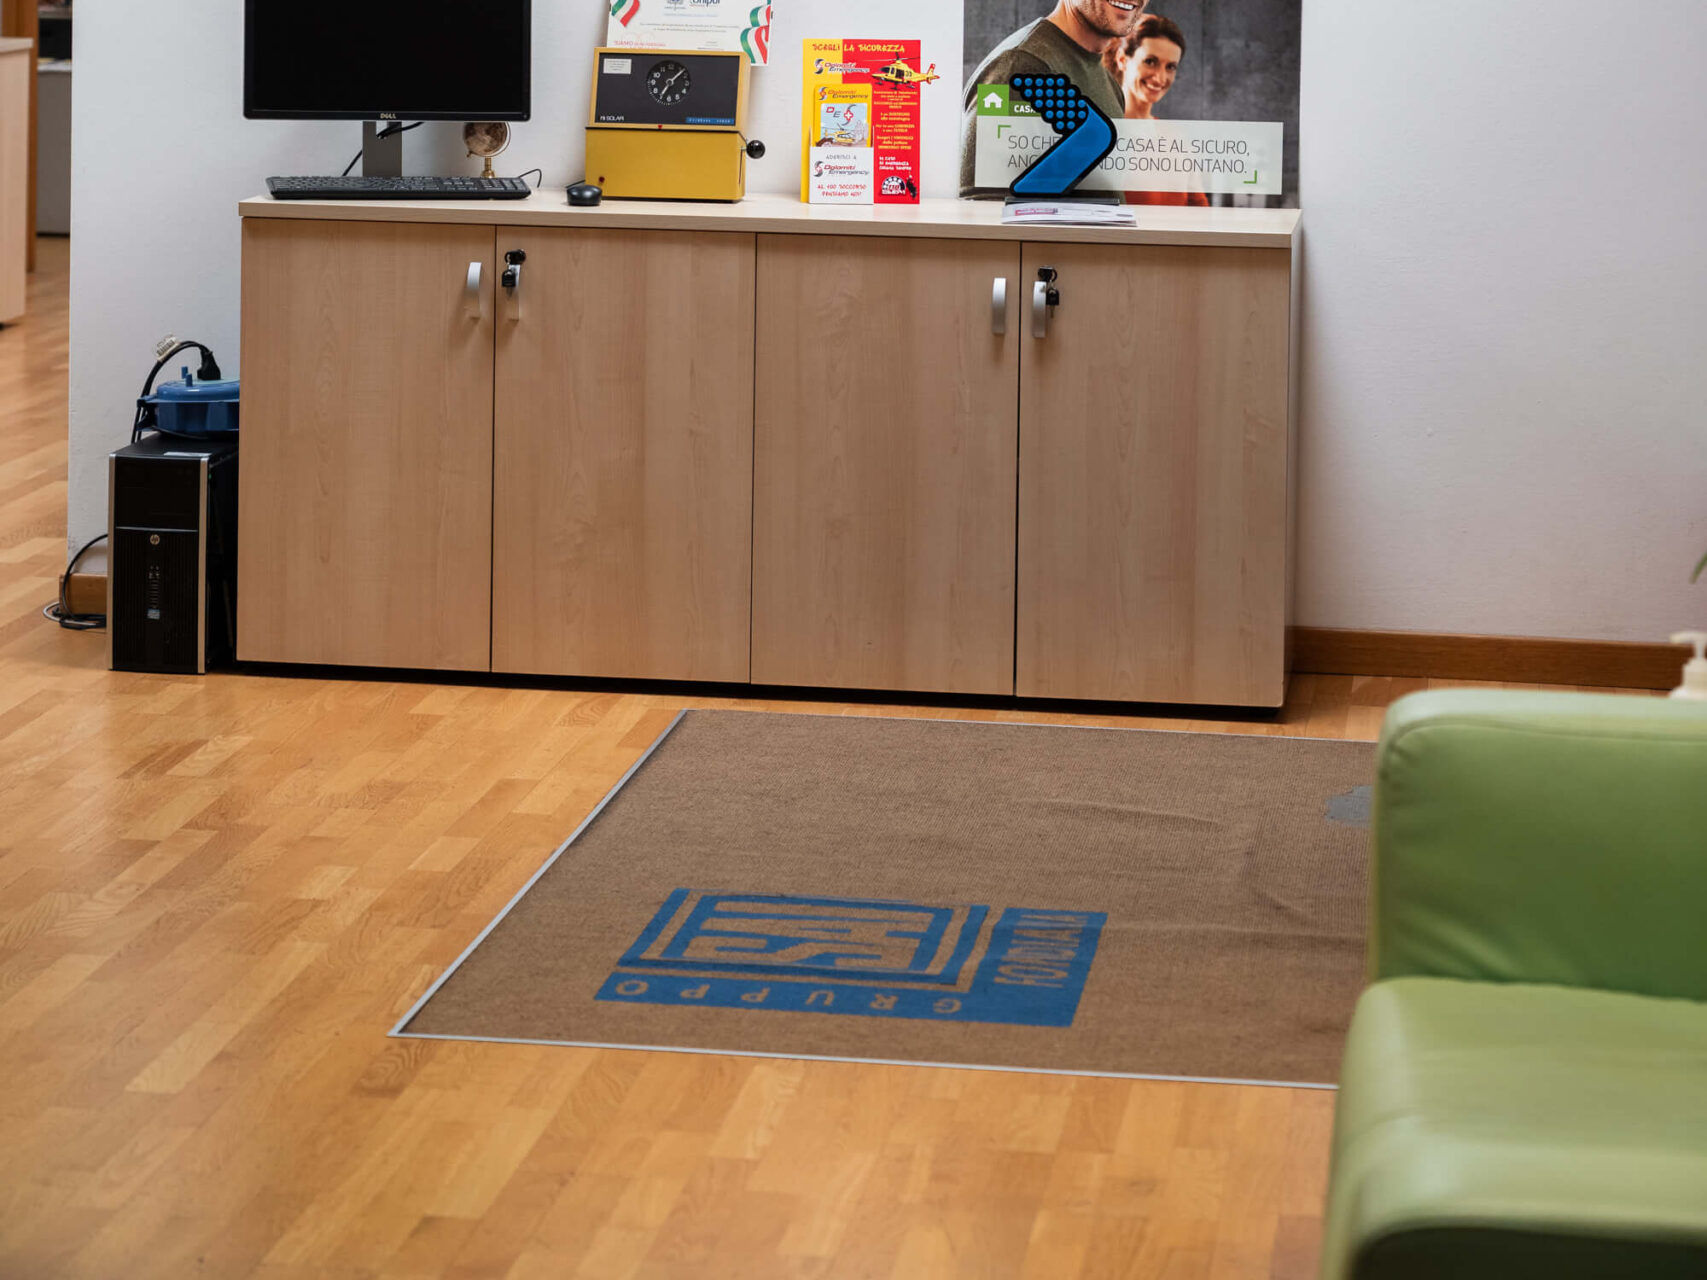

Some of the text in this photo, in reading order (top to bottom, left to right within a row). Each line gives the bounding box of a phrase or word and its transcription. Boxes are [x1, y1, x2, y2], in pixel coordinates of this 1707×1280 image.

[1008, 136, 1028, 150] SO
[1116, 138, 1155, 152] CASA
[1158, 137, 1167, 152] È
[1170, 139, 1188, 153] AL
[1191, 140, 1250, 156] SICURO,
[1008, 154, 1247, 174] ANC NDO SONO LONTANO.
[616, 979, 962, 1014] GRUPPO
